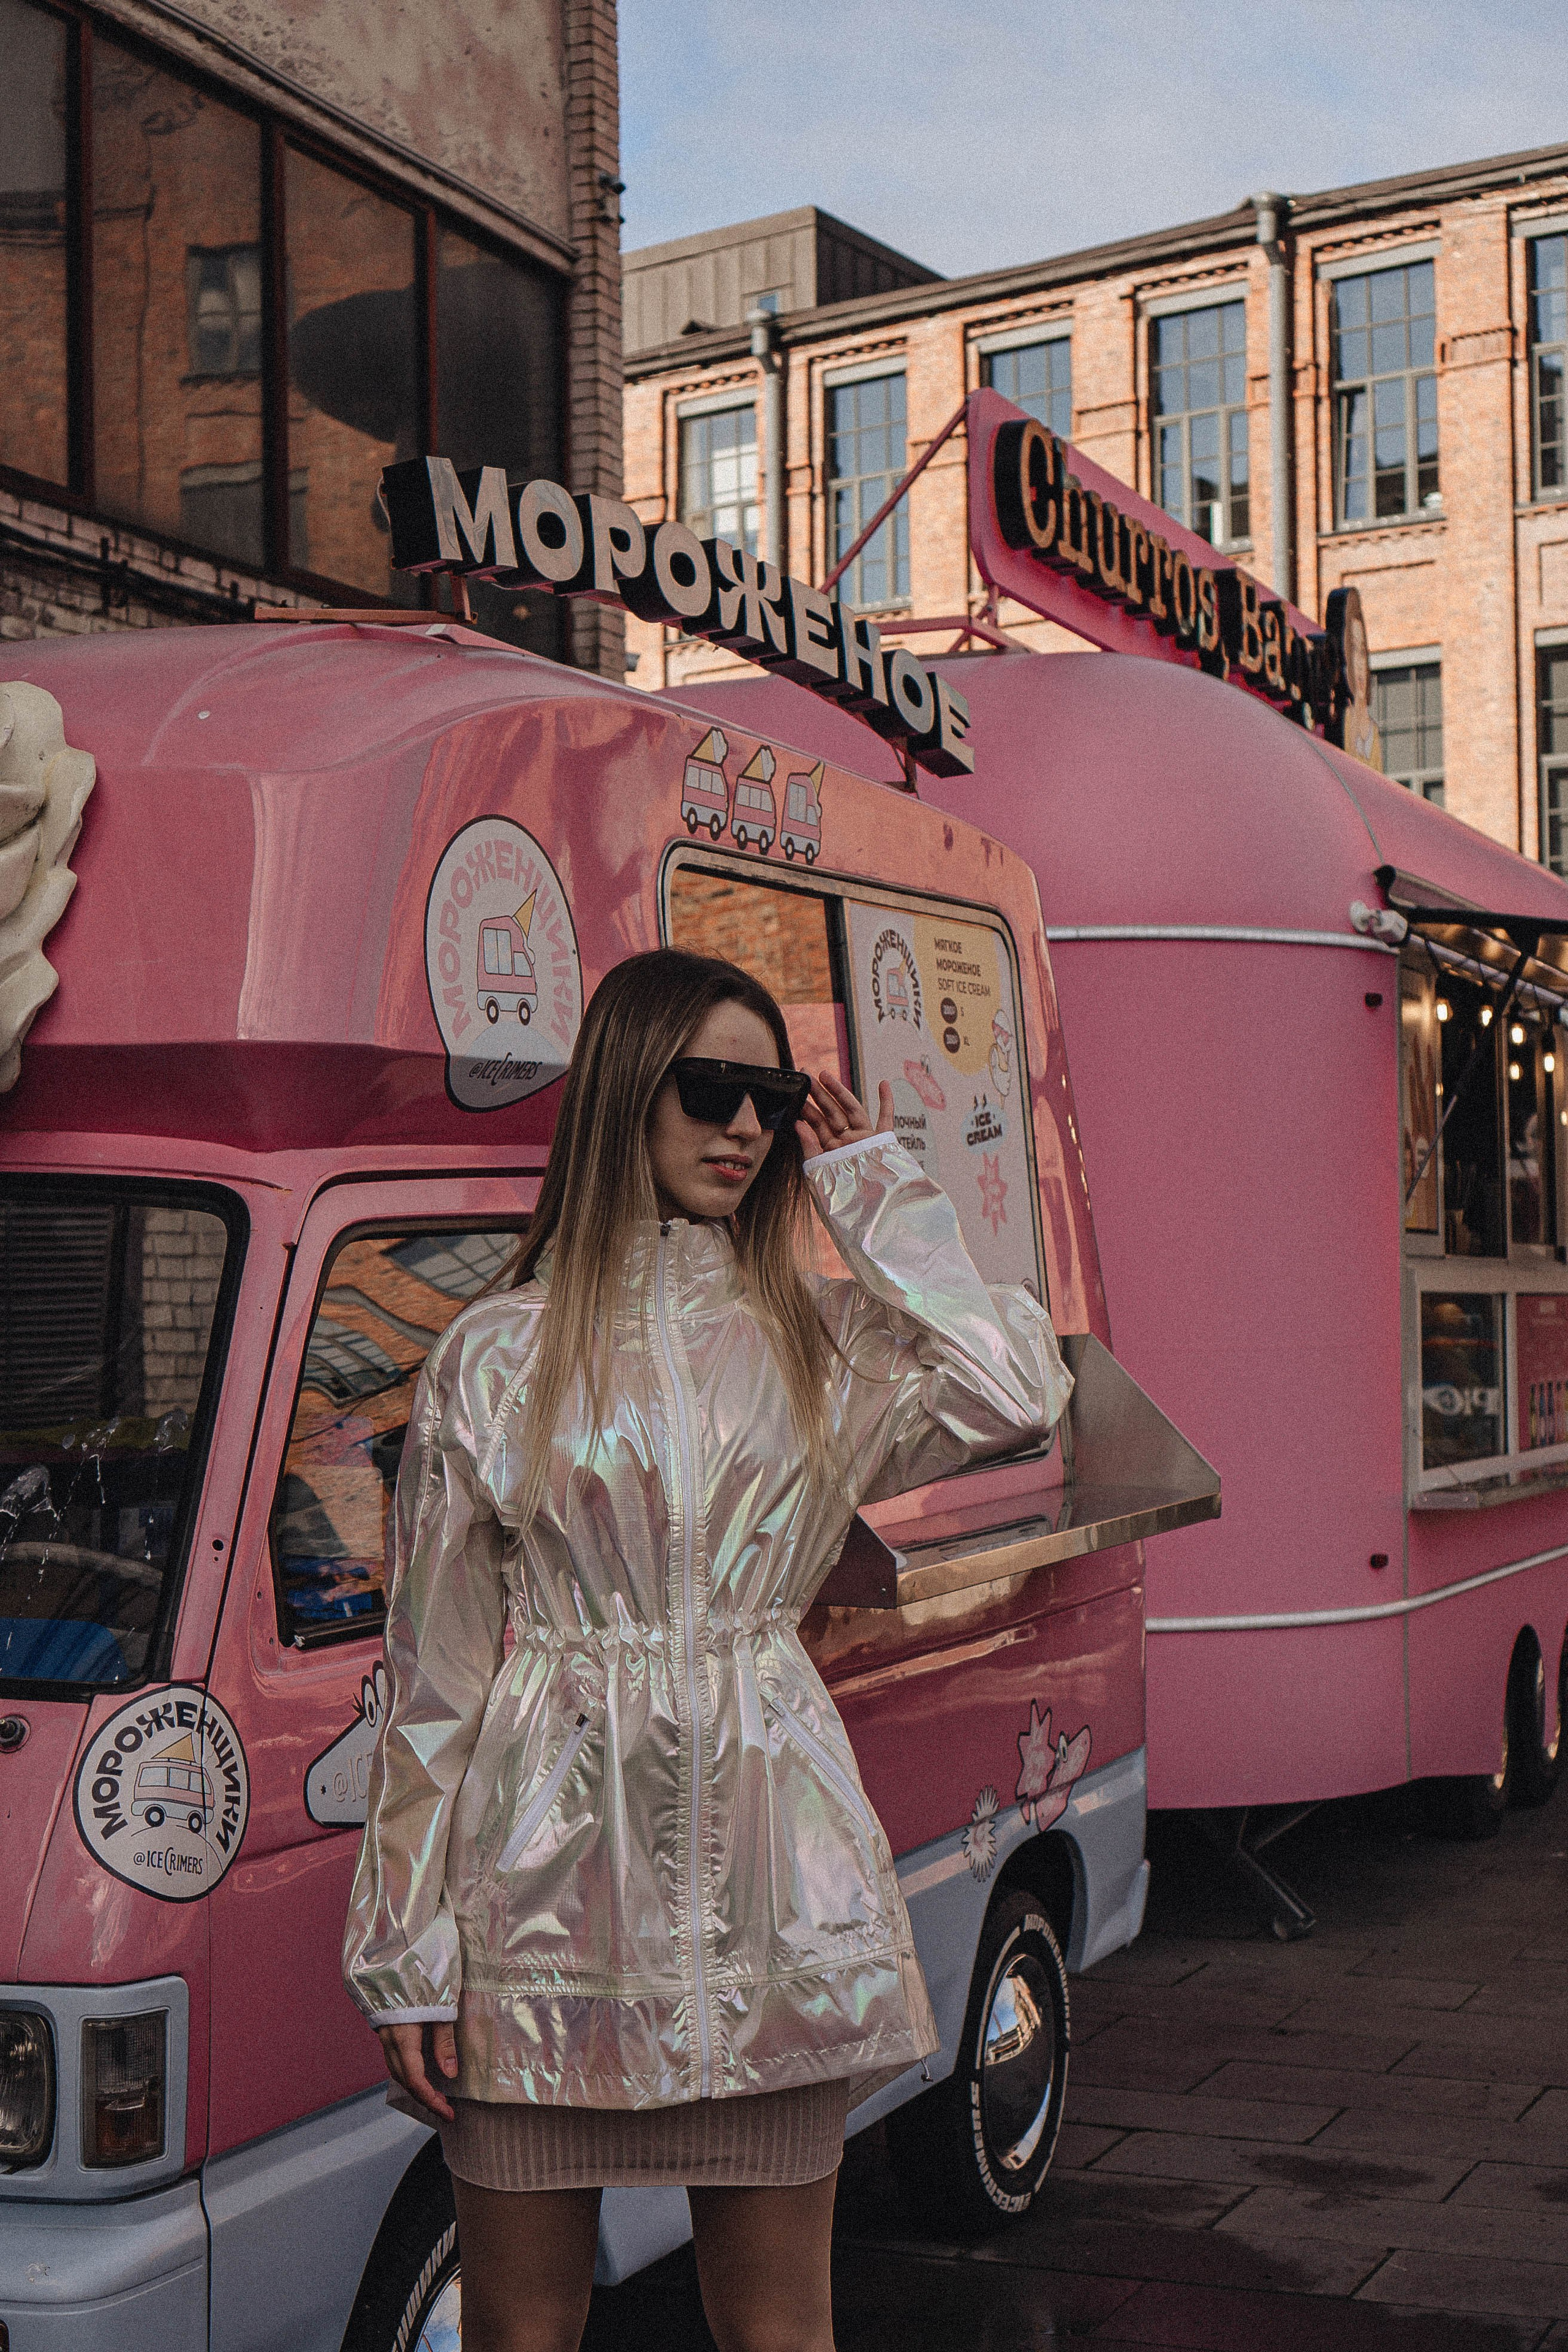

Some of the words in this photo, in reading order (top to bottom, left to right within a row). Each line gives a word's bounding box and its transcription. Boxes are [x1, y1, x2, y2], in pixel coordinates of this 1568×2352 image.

[423, 455, 975, 778] МОРОЖЕНОЕ
[936, 958, 981, 977] МОРОЖЕНОЕ
[967, 1124, 1003, 1146] CREAM
[91, 1701, 241, 1853] МОРОЖЕНЩИКИ
[134, 1847, 203, 1875] @ICECRIMERS
